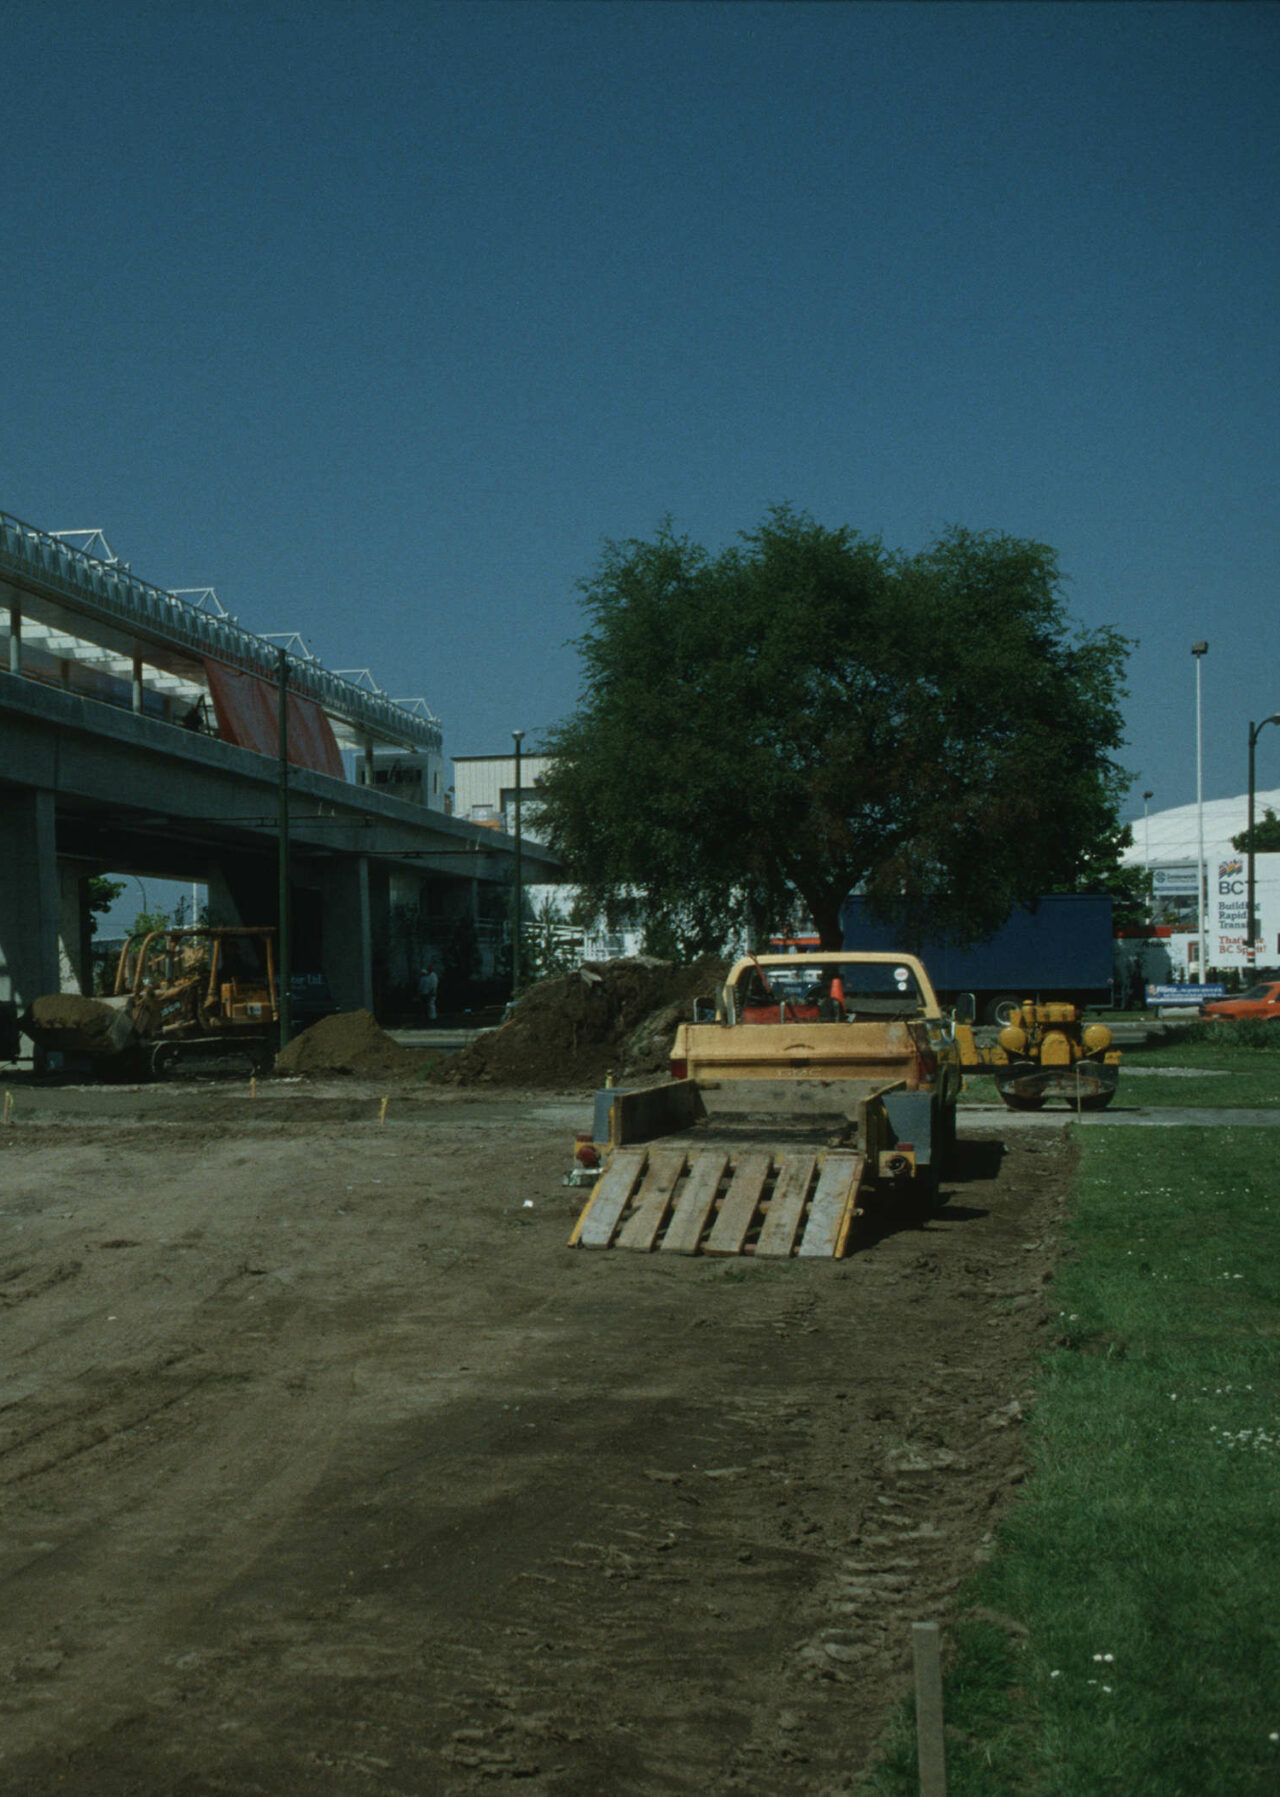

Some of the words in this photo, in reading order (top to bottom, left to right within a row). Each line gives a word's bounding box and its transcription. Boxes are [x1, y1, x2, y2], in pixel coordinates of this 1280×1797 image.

[1218, 881, 1244, 895] BC
[1218, 901, 1261, 911] Buildig
[1218, 911, 1247, 922] Rapid
[1218, 945, 1234, 954] BC
